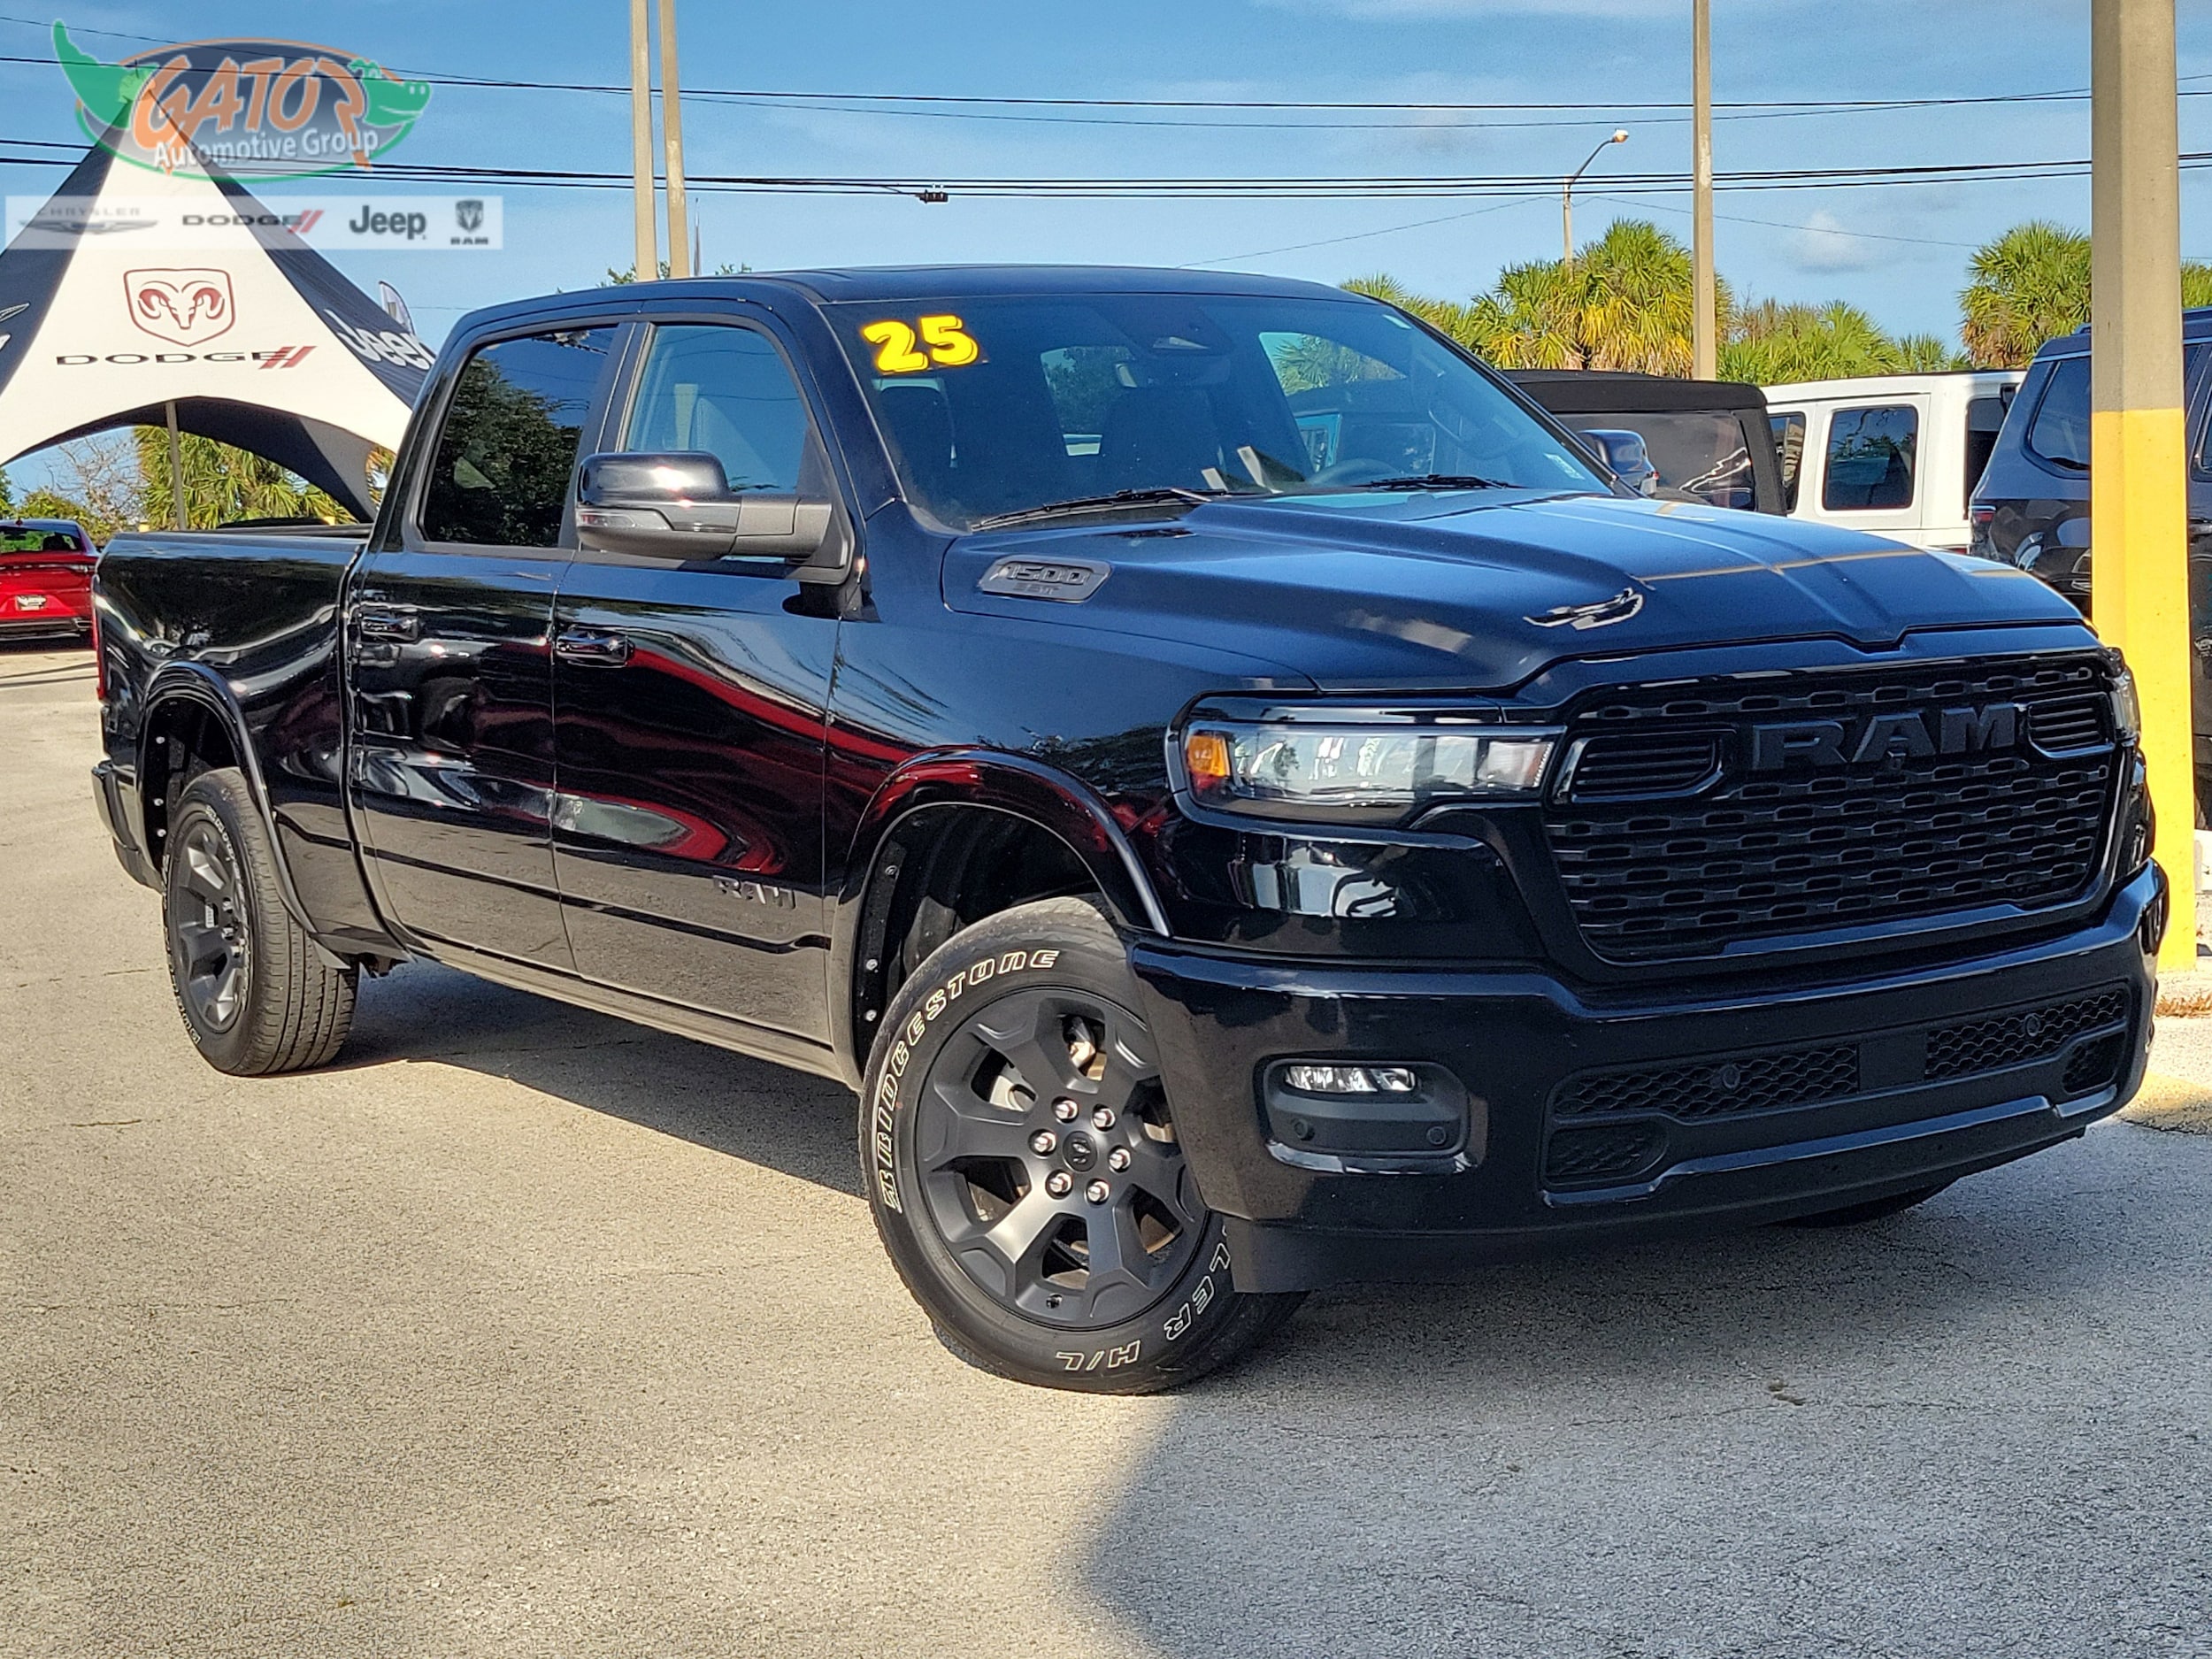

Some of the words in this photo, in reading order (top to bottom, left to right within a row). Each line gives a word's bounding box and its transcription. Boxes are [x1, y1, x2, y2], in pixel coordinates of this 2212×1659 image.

[56, 350, 290, 365] DODGE
[863, 315, 979, 373] 25
[1006, 564, 1091, 585] 1500
[1752, 703, 2017, 771] RAM
[876, 949, 1061, 1215] BRIDGESTONE
[1163, 1224, 1232, 1340] LER
[1055, 1339, 1141, 1371] H/L
